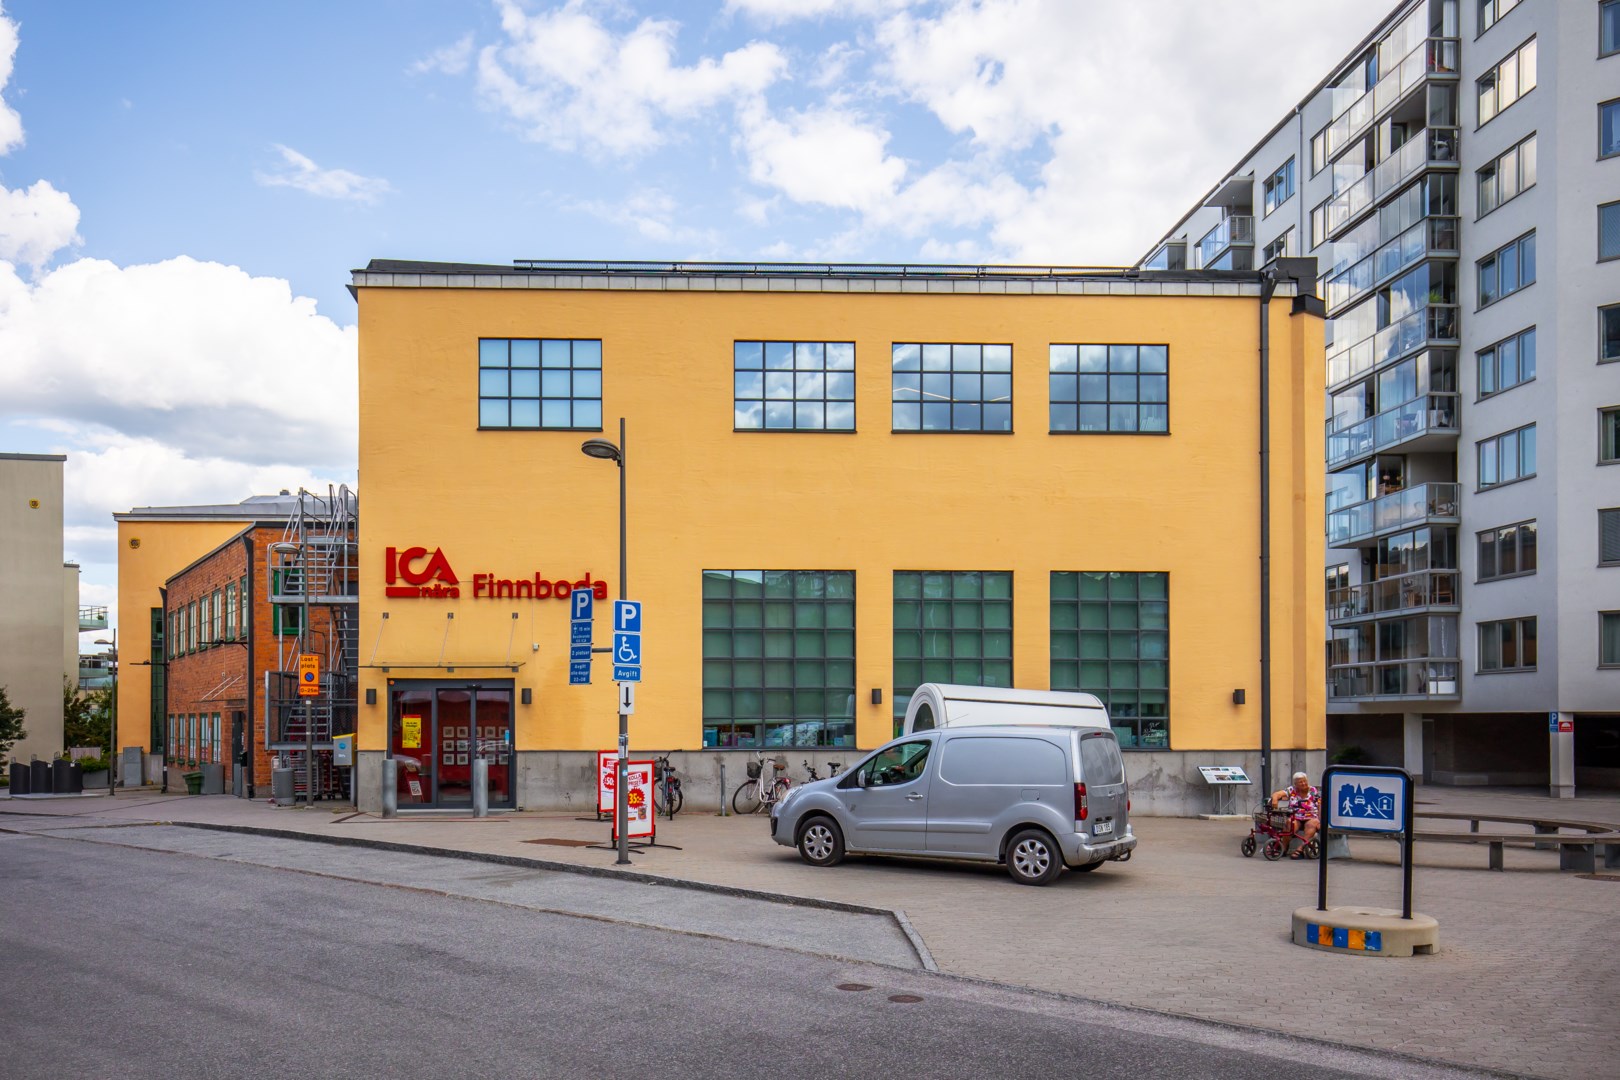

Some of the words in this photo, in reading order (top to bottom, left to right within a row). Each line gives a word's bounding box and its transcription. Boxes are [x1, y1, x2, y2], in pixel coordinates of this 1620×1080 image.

[386, 547, 459, 585] ICA
[422, 584, 459, 598] nära
[473, 572, 607, 599] Finnboda
[577, 592, 589, 617] P
[621, 604, 637, 629] P
[617, 670, 638, 678] Avgift
